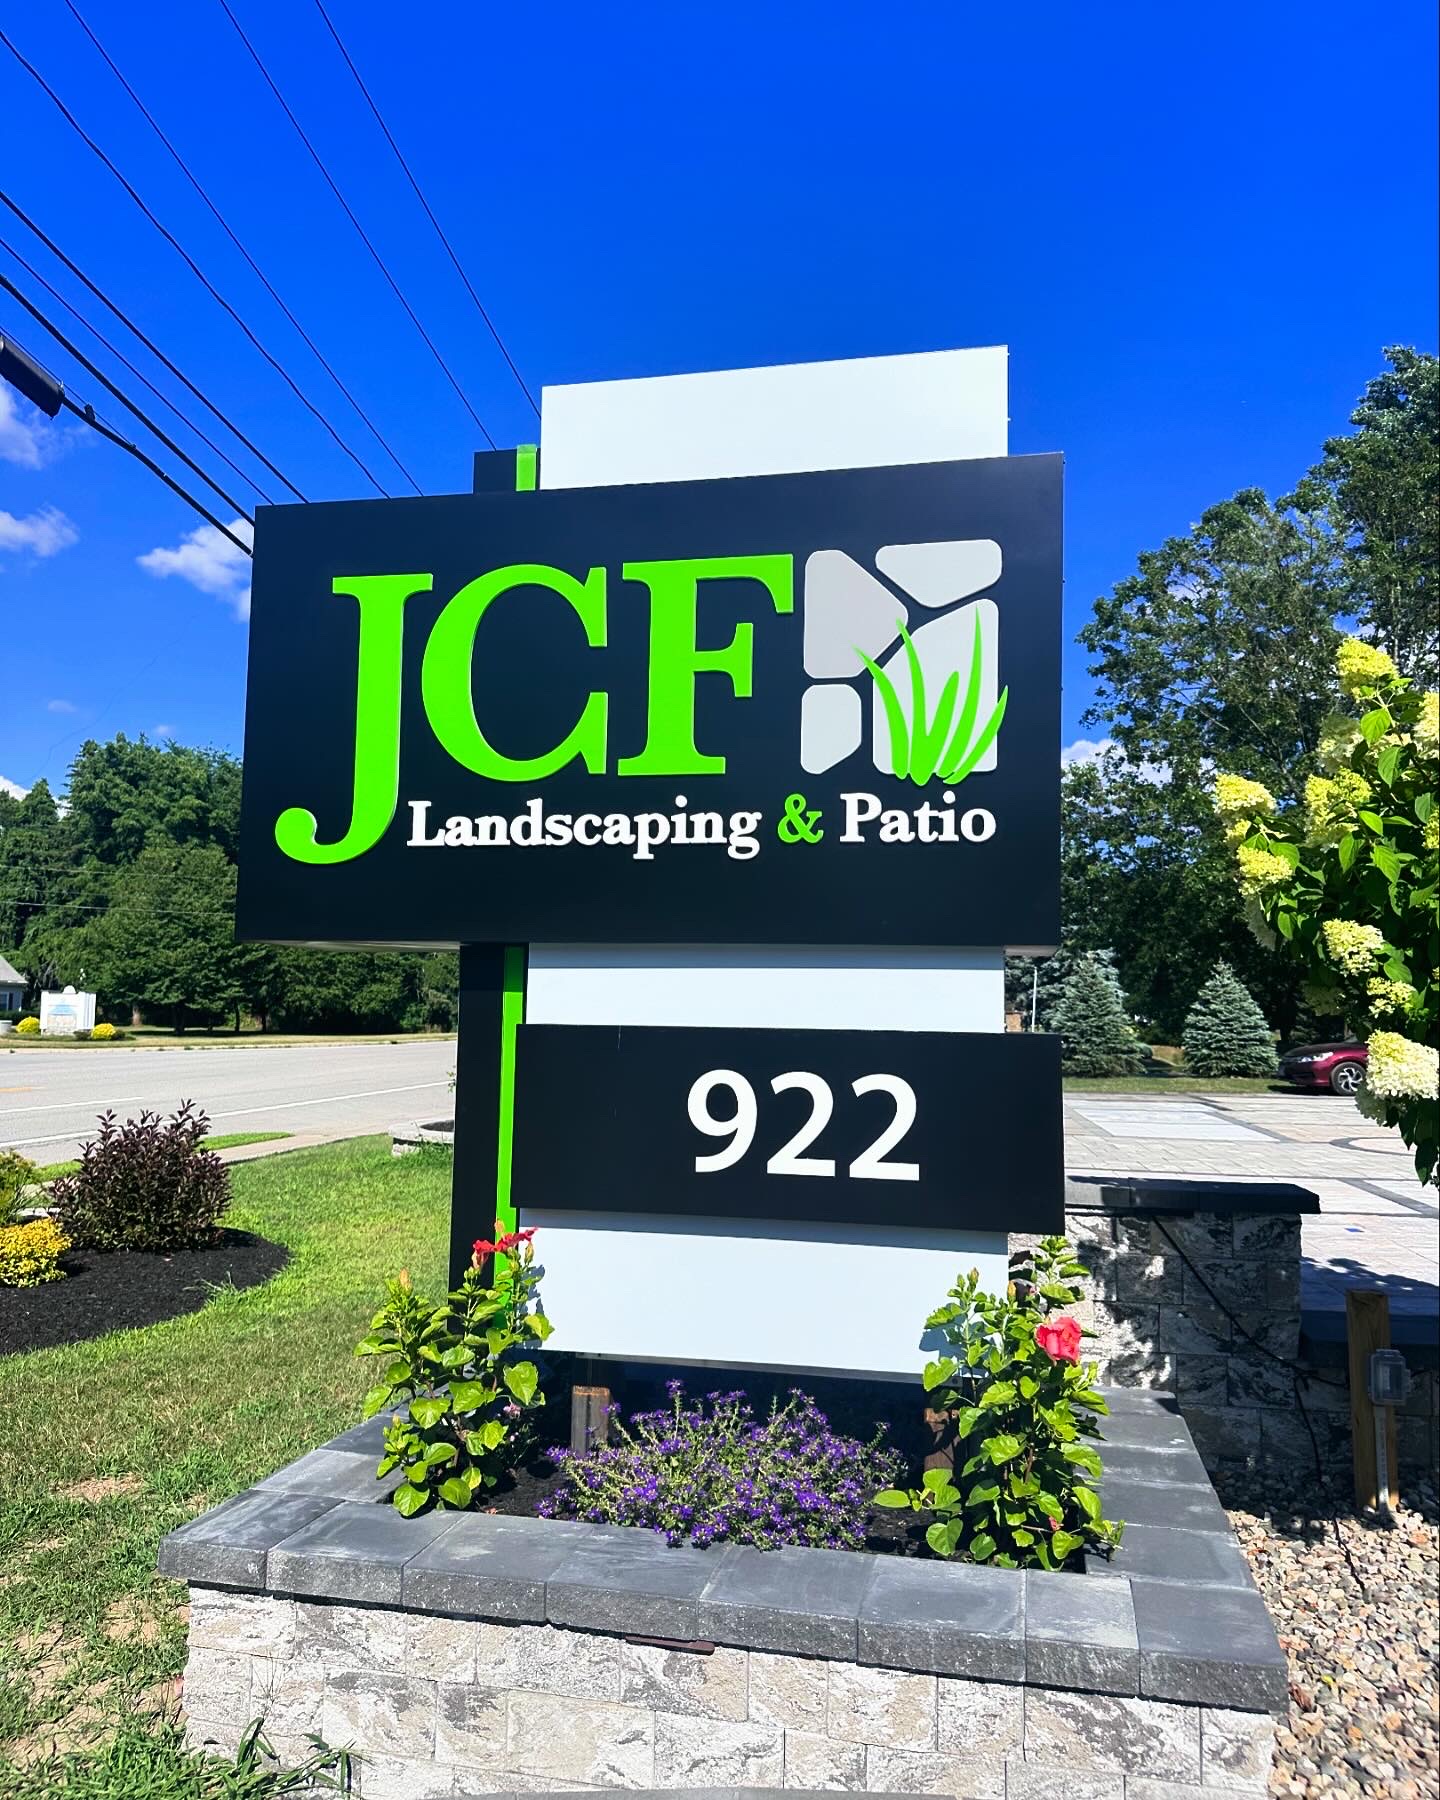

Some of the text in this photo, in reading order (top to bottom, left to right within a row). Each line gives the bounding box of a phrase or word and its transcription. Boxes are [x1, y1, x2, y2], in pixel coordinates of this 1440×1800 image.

[274, 553, 795, 865] JCF
[406, 790, 998, 860] Landscaping & Patio
[687, 1069, 921, 1182] 922
